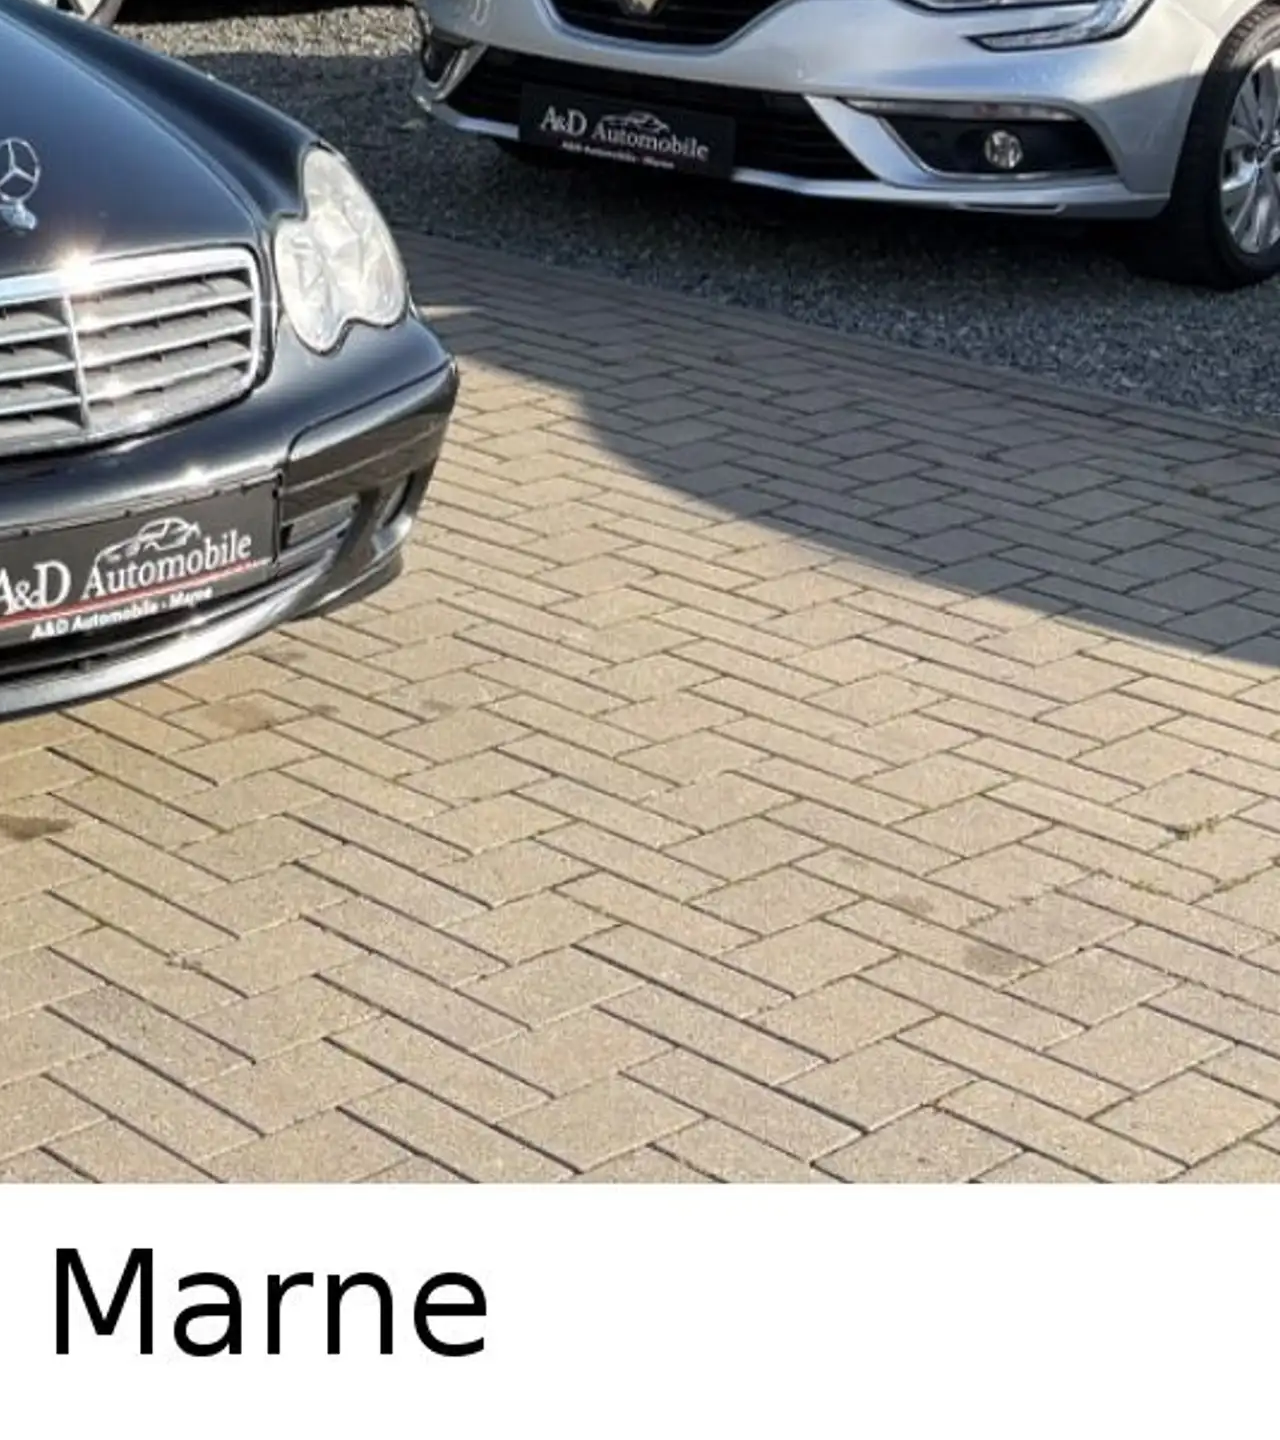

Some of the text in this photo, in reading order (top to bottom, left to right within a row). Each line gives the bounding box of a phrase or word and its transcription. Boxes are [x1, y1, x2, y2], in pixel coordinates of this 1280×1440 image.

[540, 105, 588, 137] A&D
[591, 120, 709, 161] Automobile
[80, 529, 253, 601] Automobile
